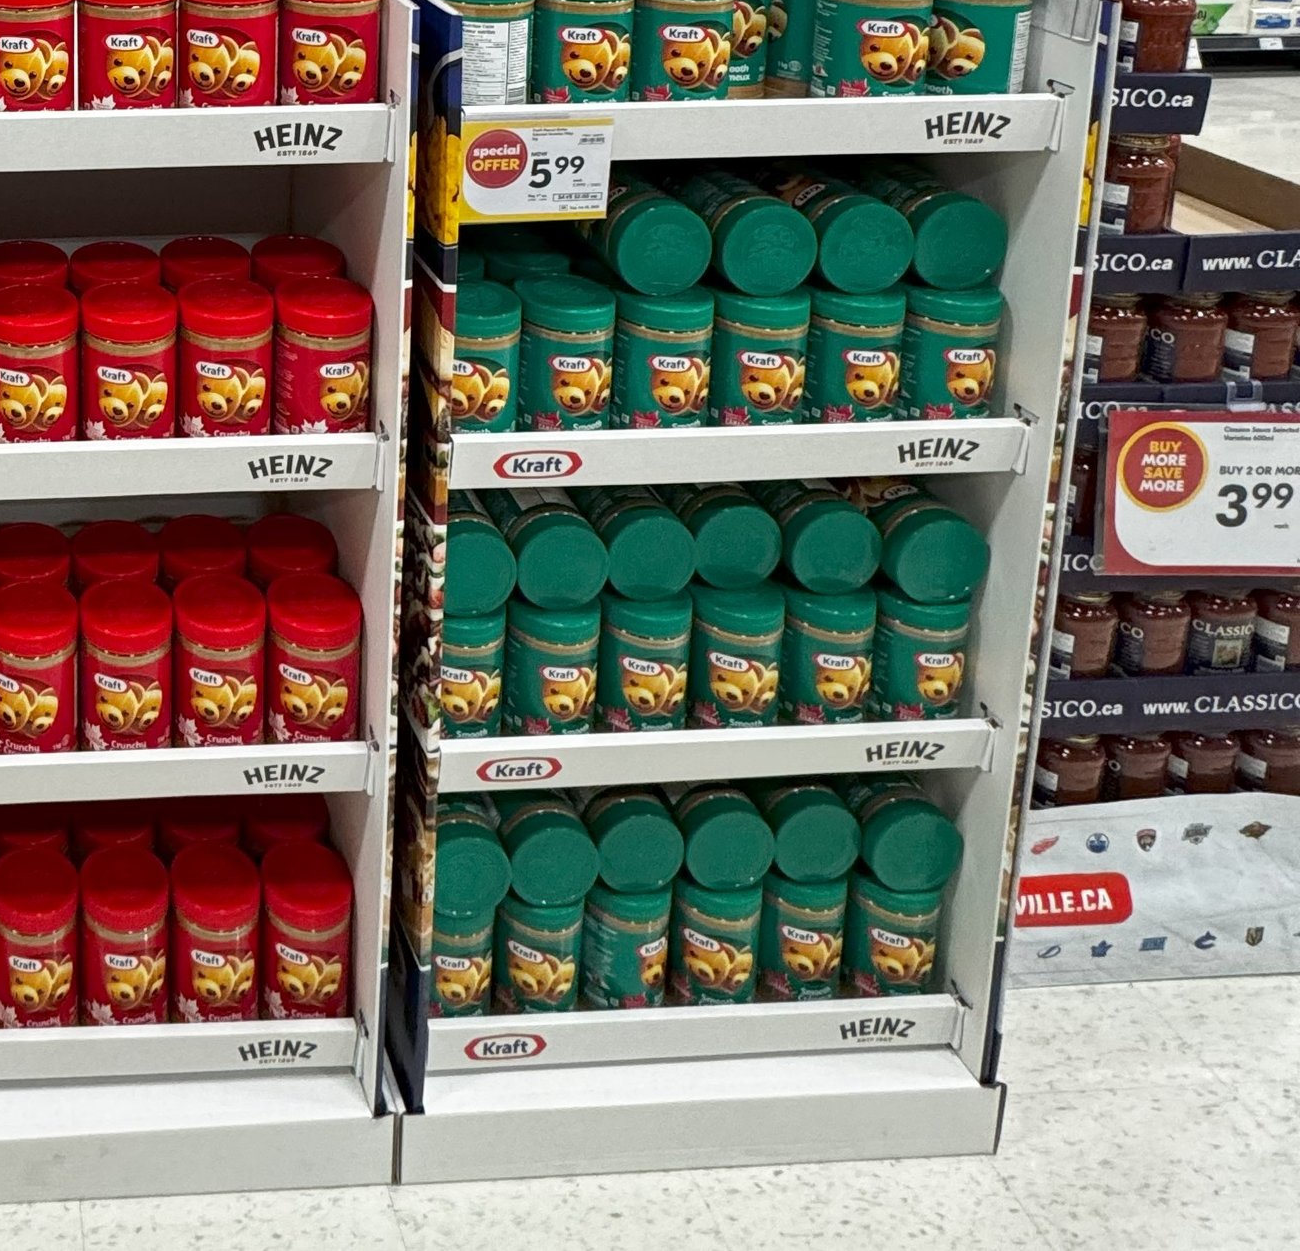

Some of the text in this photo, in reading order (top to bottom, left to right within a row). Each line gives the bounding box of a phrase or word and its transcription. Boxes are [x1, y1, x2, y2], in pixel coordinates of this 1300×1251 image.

[566, 27, 598, 42] Kraft
[0, 37, 30, 51] Kraft
[1110, 88, 1194, 108] SICO.ca
[254, 123, 343, 152] HEINZ
[473, 144, 520, 158] special
[472, 158, 520, 171] OFFER
[1202, 249, 1300, 271] www. CLA
[1150, 441, 1182, 453] BUY
[1141, 454, 1187, 466] MORE
[1143, 467, 1182, 479] SAVE
[1219, 466, 1300, 475] BUY 2 OR MOR
[1139, 480, 1185, 492] MORE
[1192, 620, 1254, 637] CLASSIC
[1041, 700, 1123, 718] SICO.ca
[1143, 702, 1190, 715] www.
[1016, 888, 1113, 915] VILLE.CA
[482, 1040, 529, 1056] Kraft
